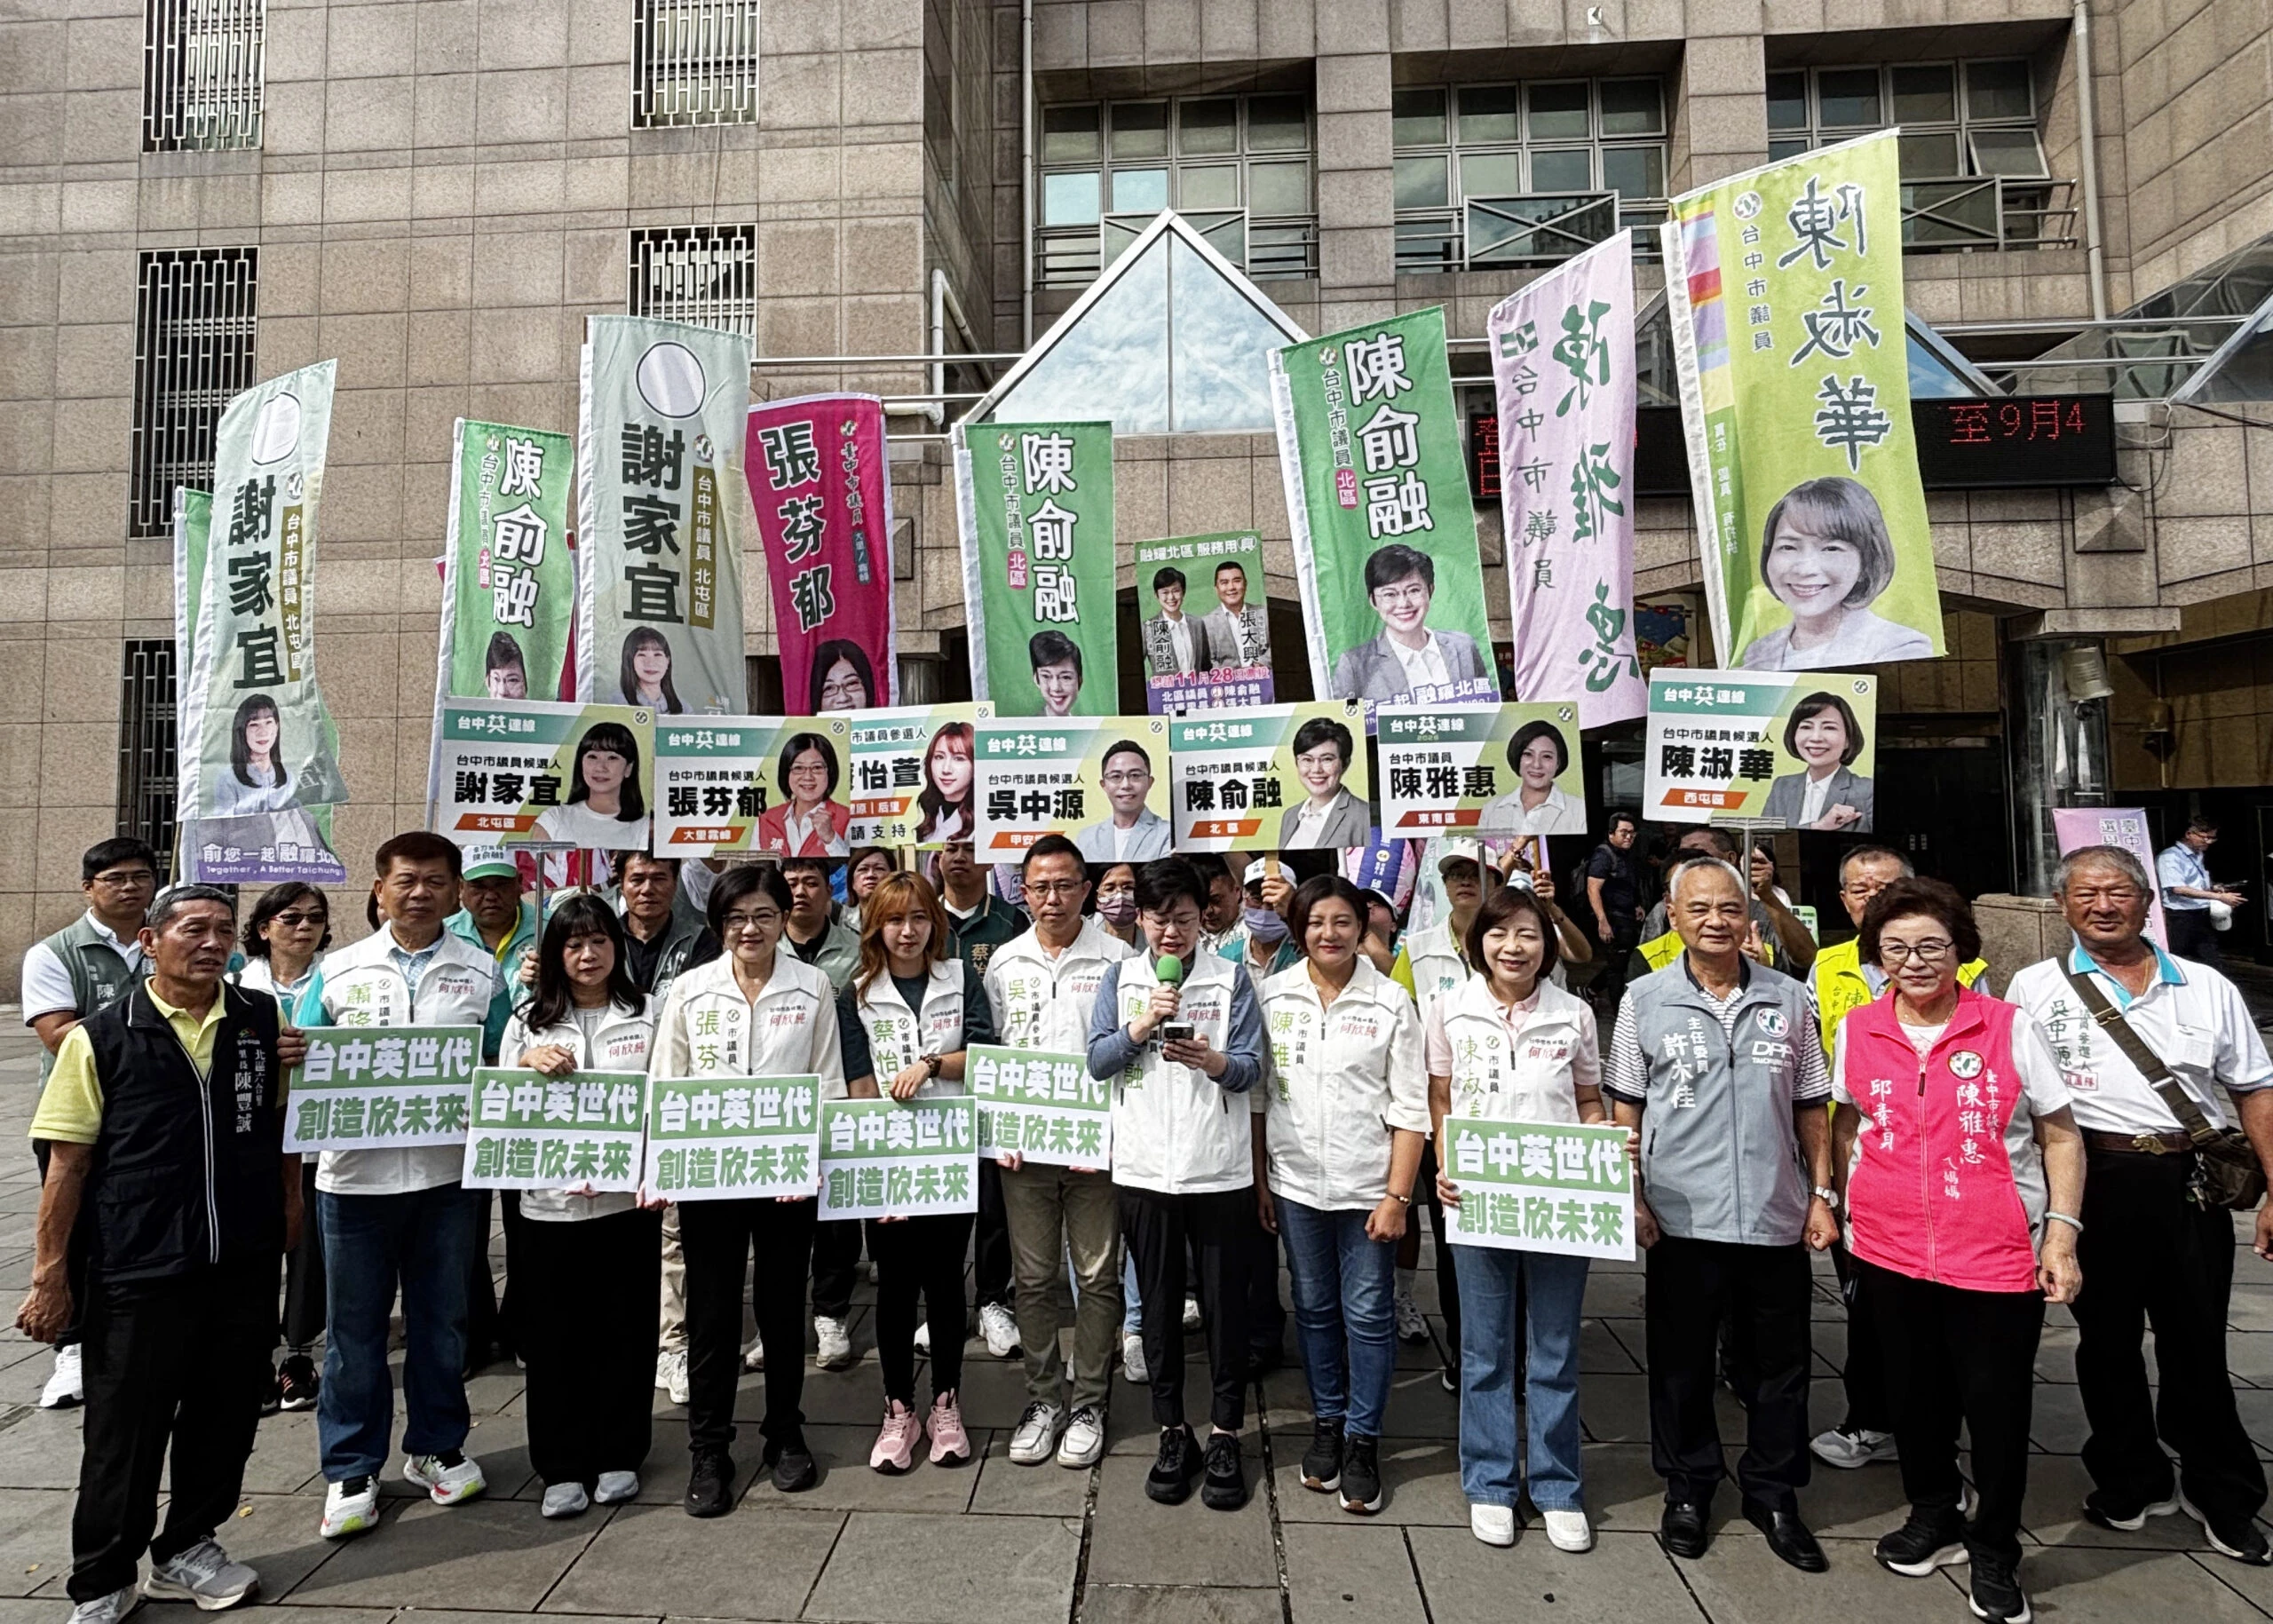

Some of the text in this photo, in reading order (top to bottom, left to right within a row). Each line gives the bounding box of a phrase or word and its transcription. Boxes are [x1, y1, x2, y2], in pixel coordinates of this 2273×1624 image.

[1322, 369, 1357, 505] 台中市議員 北區
[1343, 332, 1435, 538] 陳俞融
[1949, 400, 2086, 443] 至9月4
[492, 436, 549, 629] 陳俞融
[622, 424, 685, 625] 謝家宜
[760, 420, 836, 634] 張芬郁
[1000, 456, 1026, 587] 台中市議員 北區
[1021, 432, 1080, 624] 陳俞融
[694, 475, 713, 619] 台中市議員 北屯區
[226, 474, 286, 690] 謝家宜
[281, 512, 303, 669] 台中市議員 北屯區
[1153, 621, 1174, 671] 陳俞融
[1240, 612, 1259, 662] 張大興
[1664, 686, 1746, 706] 台中英連線
[458, 714, 535, 734] 台中英連線
[669, 731, 741, 749] 台中英連線
[852, 727, 927, 742] 市議員參選人
[1183, 723, 1253, 741] 台中英連線
[1390, 717, 1465, 734] 台中英連線
[1663, 727, 1774, 744] 台中市議員候選人
[457, 755, 561, 769] 台中市議員候選人
[987, 734, 1066, 756] 台中英連線
[1390, 752, 1453, 764] 台中市議員
[669, 771, 766, 781] 台中市議員候選人
[851, 757, 921, 790] 怡萱
[988, 773, 1084, 786] 台中市議員候選人
[1185, 761, 1279, 775] 台中市議員候選人
[1660, 745, 1774, 782] 陳淑華
[455, 771, 561, 806] 謝家宜
[1186, 777, 1282, 812] 陳俞融
[1390, 765, 1497, 799] 陳雅惠
[1683, 792, 1725, 805] 西屯區
[669, 787, 767, 817] 張芬郁
[986, 789, 1084, 821] 吳中源
[1418, 812, 1456, 824] 東南區
[478, 817, 515, 828] 北屯區
[683, 830, 732, 841] 大里霧峰
[851, 824, 906, 840] 請支持
[1210, 822, 1239, 834] 北區
[609, 1042, 645, 1058] 何欣純
[696, 1010, 720, 1070] 張芬
[727, 1028, 737, 1064] 市議員
[1295, 1029, 1308, 1065] 市議員
[1687, 1017, 1709, 1073] 主任委員
[1752, 1041, 1794, 1058] DPP
[2050, 1000, 2071, 1066] 吳中源
[303, 1036, 471, 1082] 台中英世代
[1528, 1046, 1568, 1059] 何欣純
[973, 1056, 1105, 1104] 台中英世代
[1488, 1056, 1500, 1093] 市議員
[294, 1094, 467, 1142] 創造欣未來
[479, 1079, 638, 1126] 台中英世代
[659, 1086, 812, 1132] 台中英世代
[829, 1108, 970, 1152] 台中英世代
[1956, 1082, 1985, 1164] 陳雅惠
[471, 1137, 632, 1181] 創造欣未來
[655, 1143, 810, 1191] 創造欣未來
[1454, 1129, 1623, 1185] 台中英世代
[828, 1162, 970, 1209] 創造欣未來
[1456, 1189, 1624, 1247] 創造欣未來
